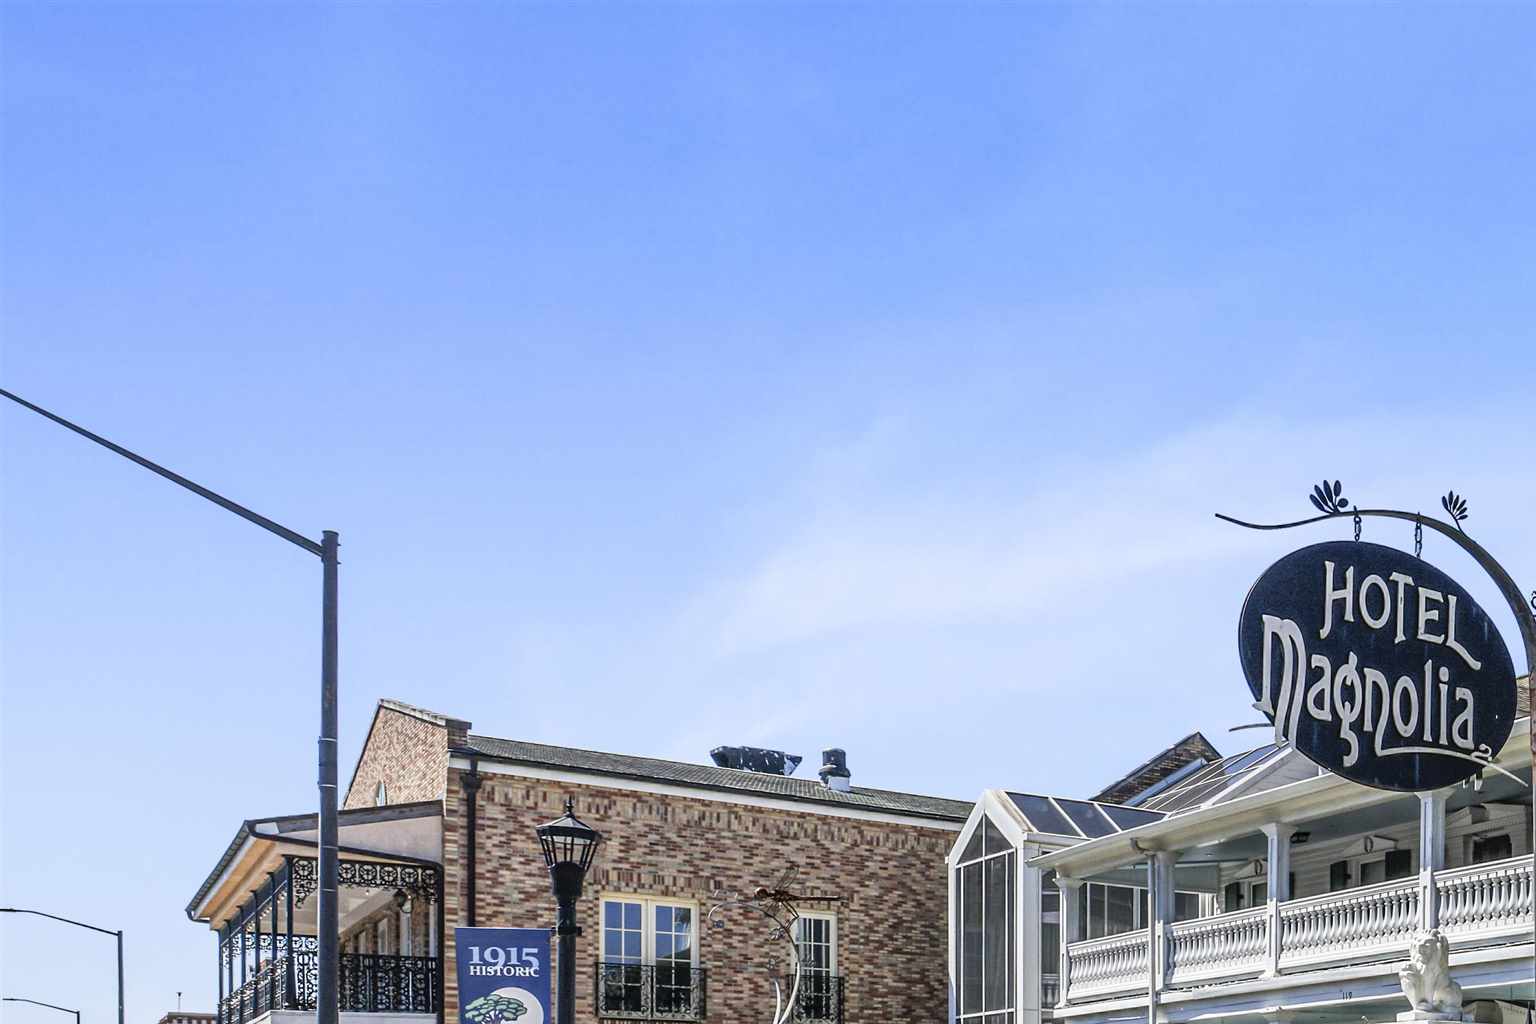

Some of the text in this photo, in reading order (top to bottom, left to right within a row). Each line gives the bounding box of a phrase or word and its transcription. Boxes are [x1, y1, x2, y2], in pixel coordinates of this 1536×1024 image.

[1319, 560, 1482, 671] HOTEL
[1253, 614, 1496, 770] Magnolia
[468, 946, 540, 970] 1915
[469, 965, 540, 977] HISTORIC
